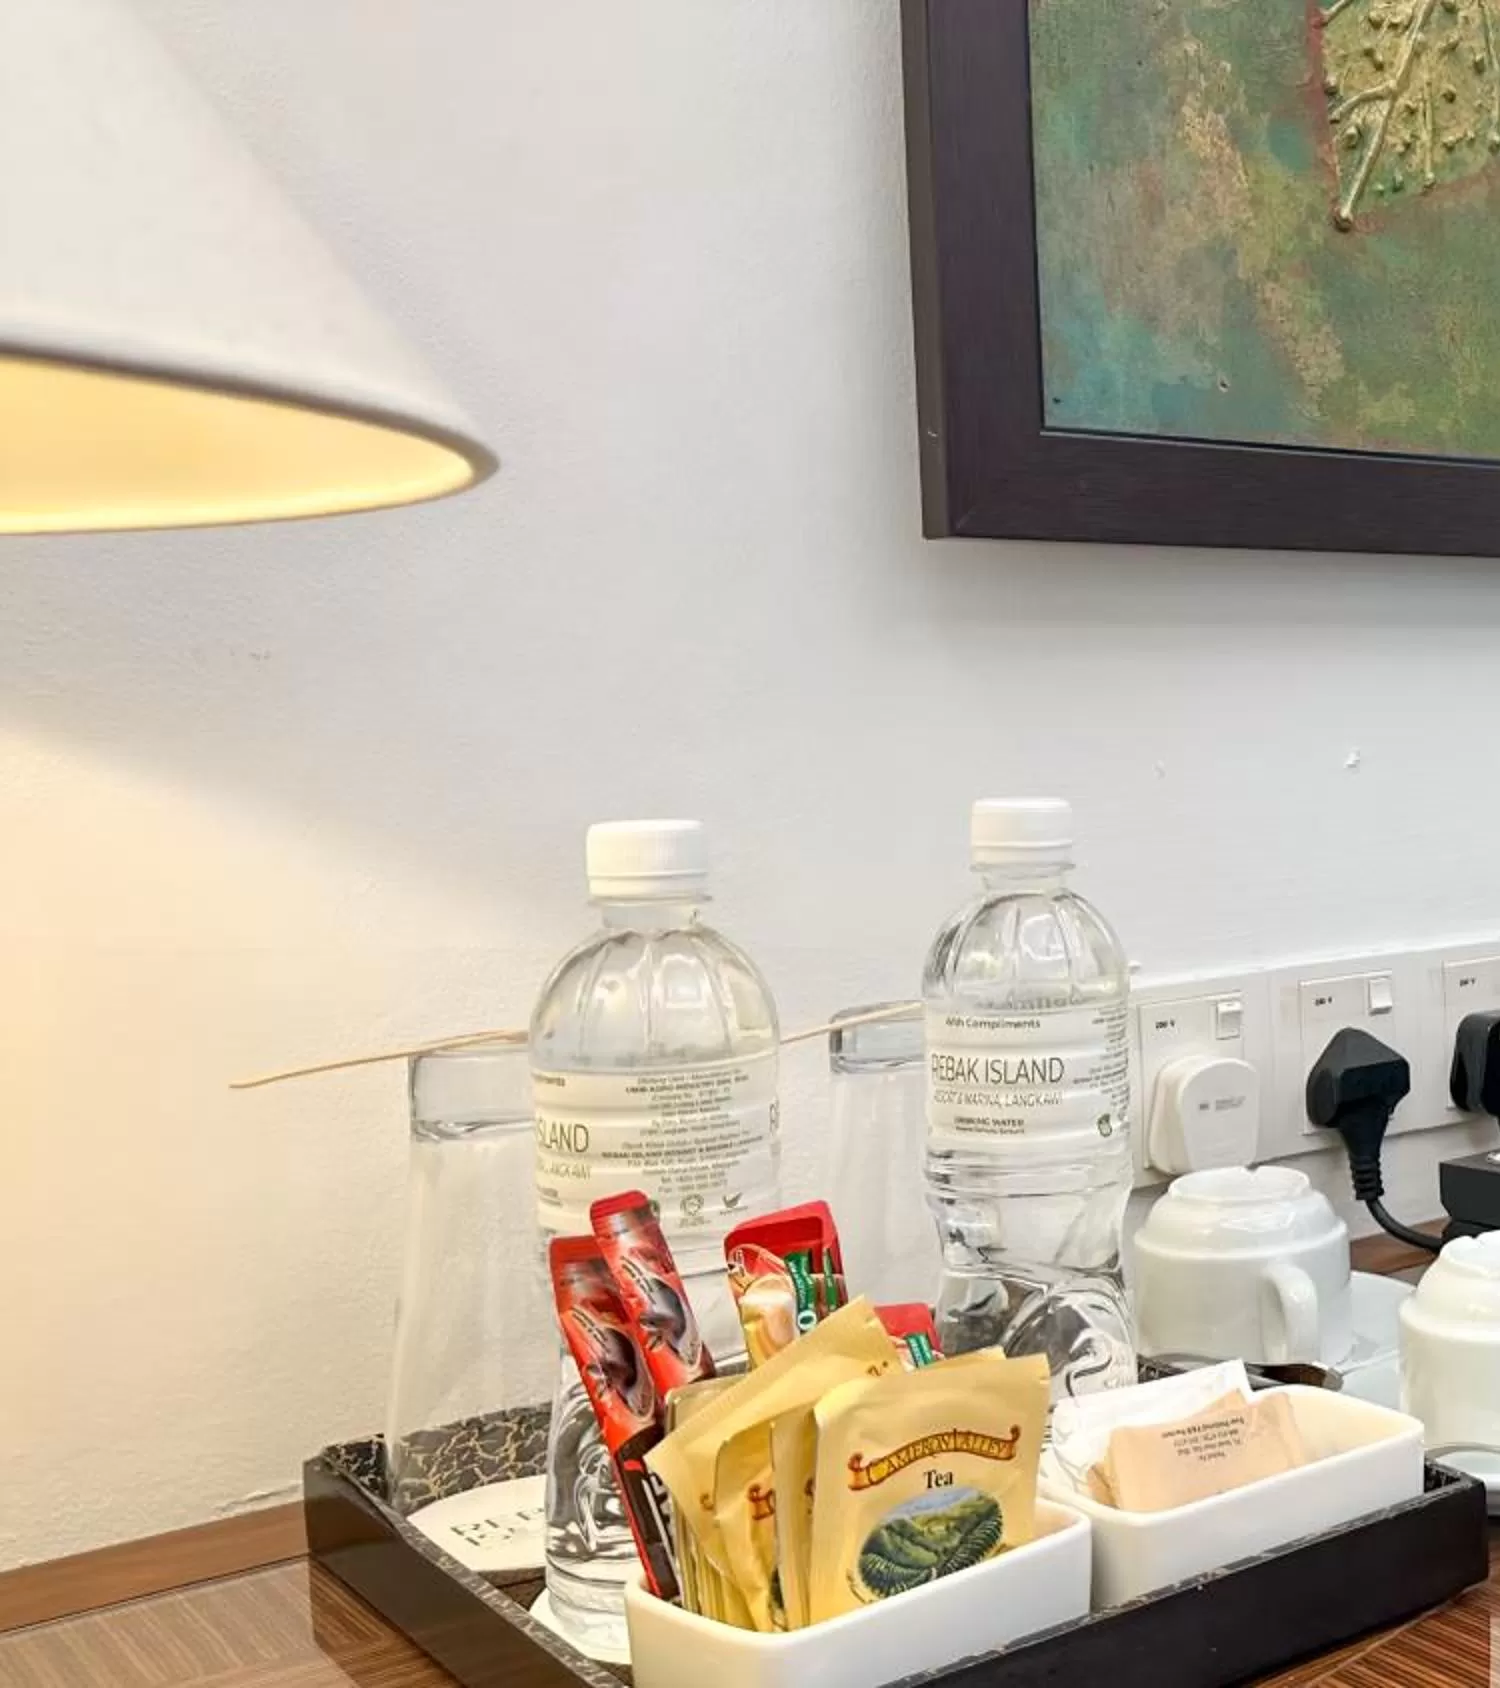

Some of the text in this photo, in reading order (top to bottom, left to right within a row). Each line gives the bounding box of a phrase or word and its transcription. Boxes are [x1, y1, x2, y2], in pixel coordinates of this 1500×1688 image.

[966, 1016, 1041, 1030] Compliments
[984, 1057, 1065, 1085] ISLAND
[536, 1119, 590, 1154] SLAND
[923, 1470, 954, 1489] Tea
